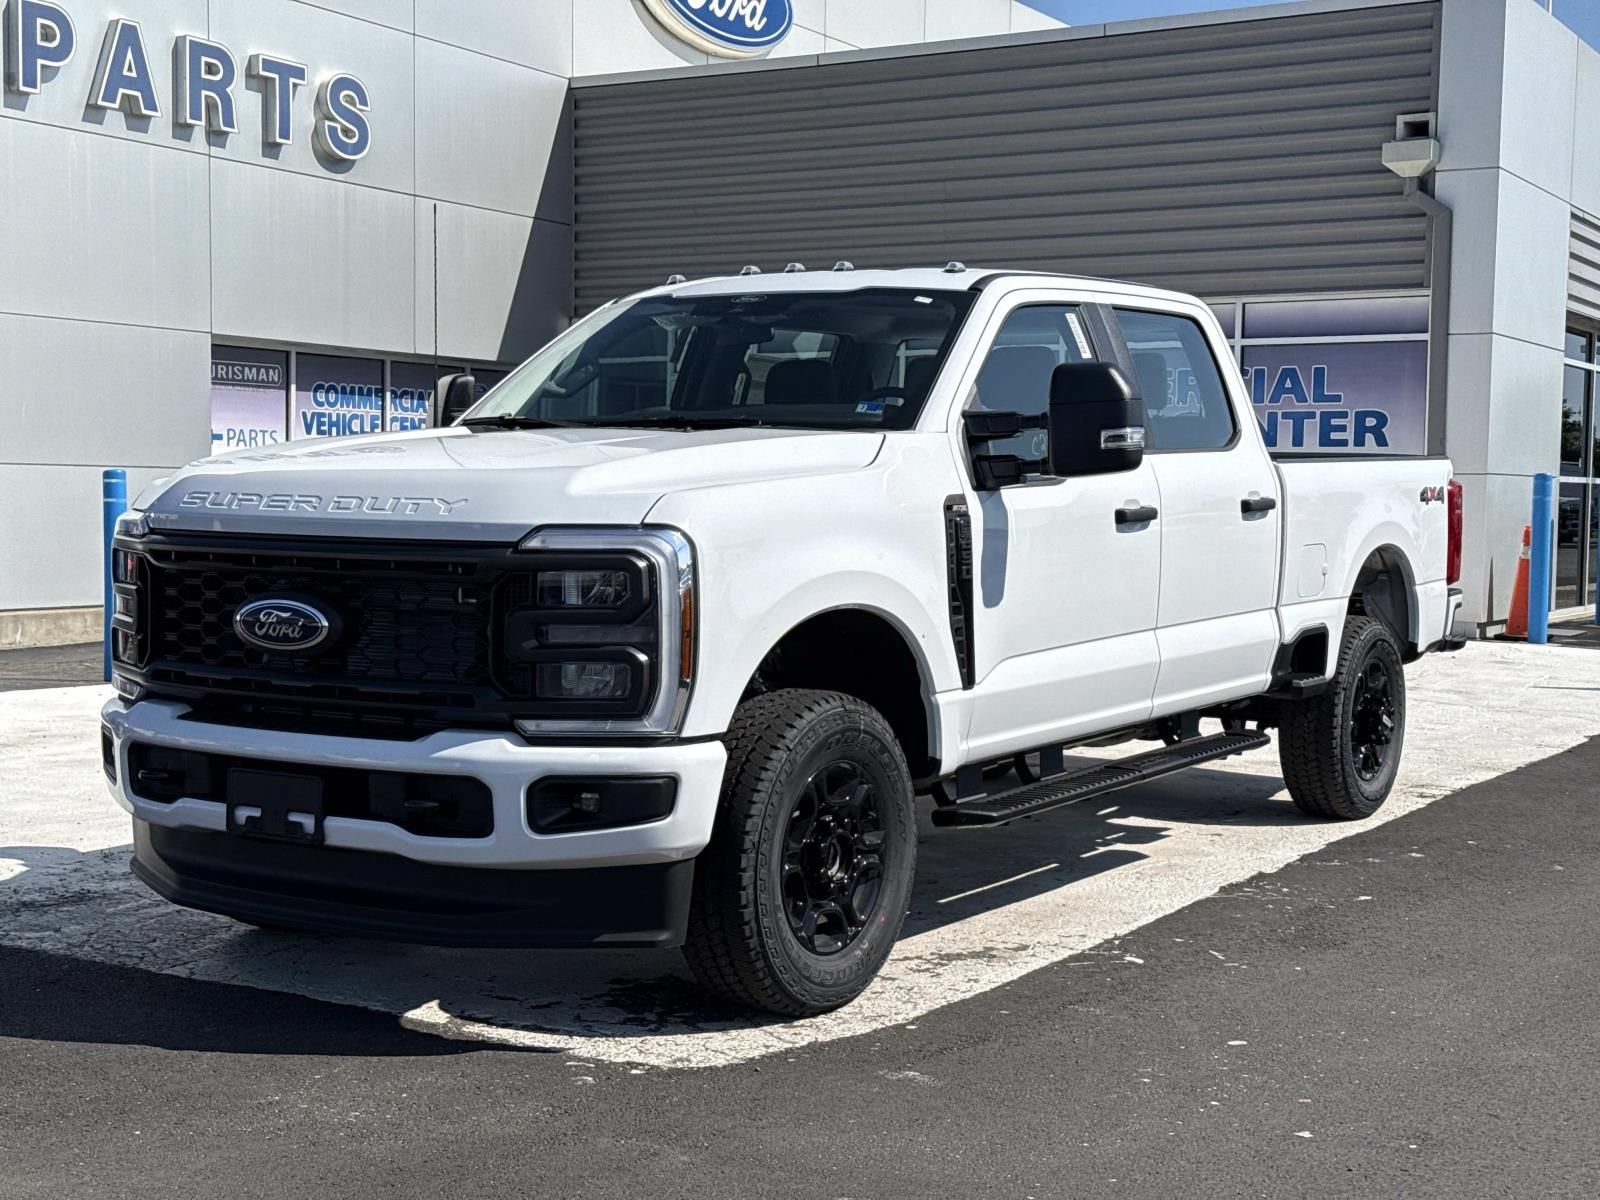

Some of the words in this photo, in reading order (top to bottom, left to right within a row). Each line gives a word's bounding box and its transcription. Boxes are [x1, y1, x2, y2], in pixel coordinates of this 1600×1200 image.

[686, 0, 768, 31] ord
[12, 0, 372, 160] PARTS
[311, 382, 434, 415] COMMERCIA
[226, 428, 278, 448] PARTS
[300, 410, 382, 437] VEHICLE
[179, 491, 321, 512] SUPER
[327, 496, 469, 515] DUTY
[255, 609, 304, 638] Ford
